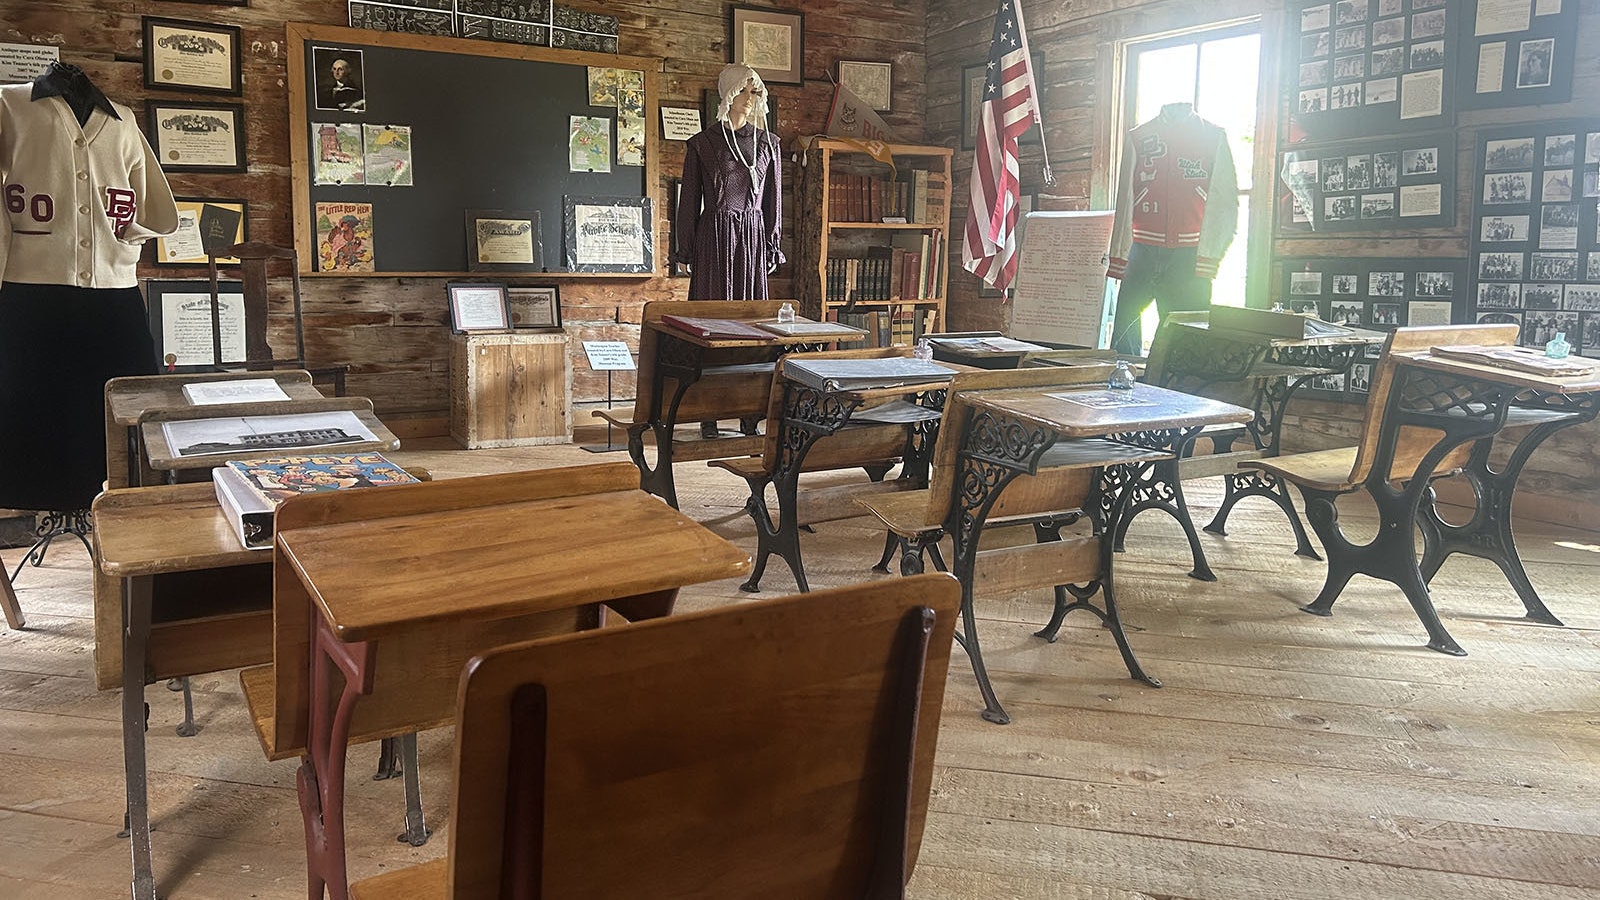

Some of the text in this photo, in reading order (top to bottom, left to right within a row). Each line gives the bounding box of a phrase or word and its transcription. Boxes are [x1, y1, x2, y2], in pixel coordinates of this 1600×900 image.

[4, 184, 54, 222] 60
[1142, 201, 1159, 213] 61
[326, 205, 344, 215] LITTLE
[344, 206, 356, 214] RED
[357, 206, 370, 214] HEN
[181, 301, 196, 310] State
[239, 455, 386, 467] POPEYE
